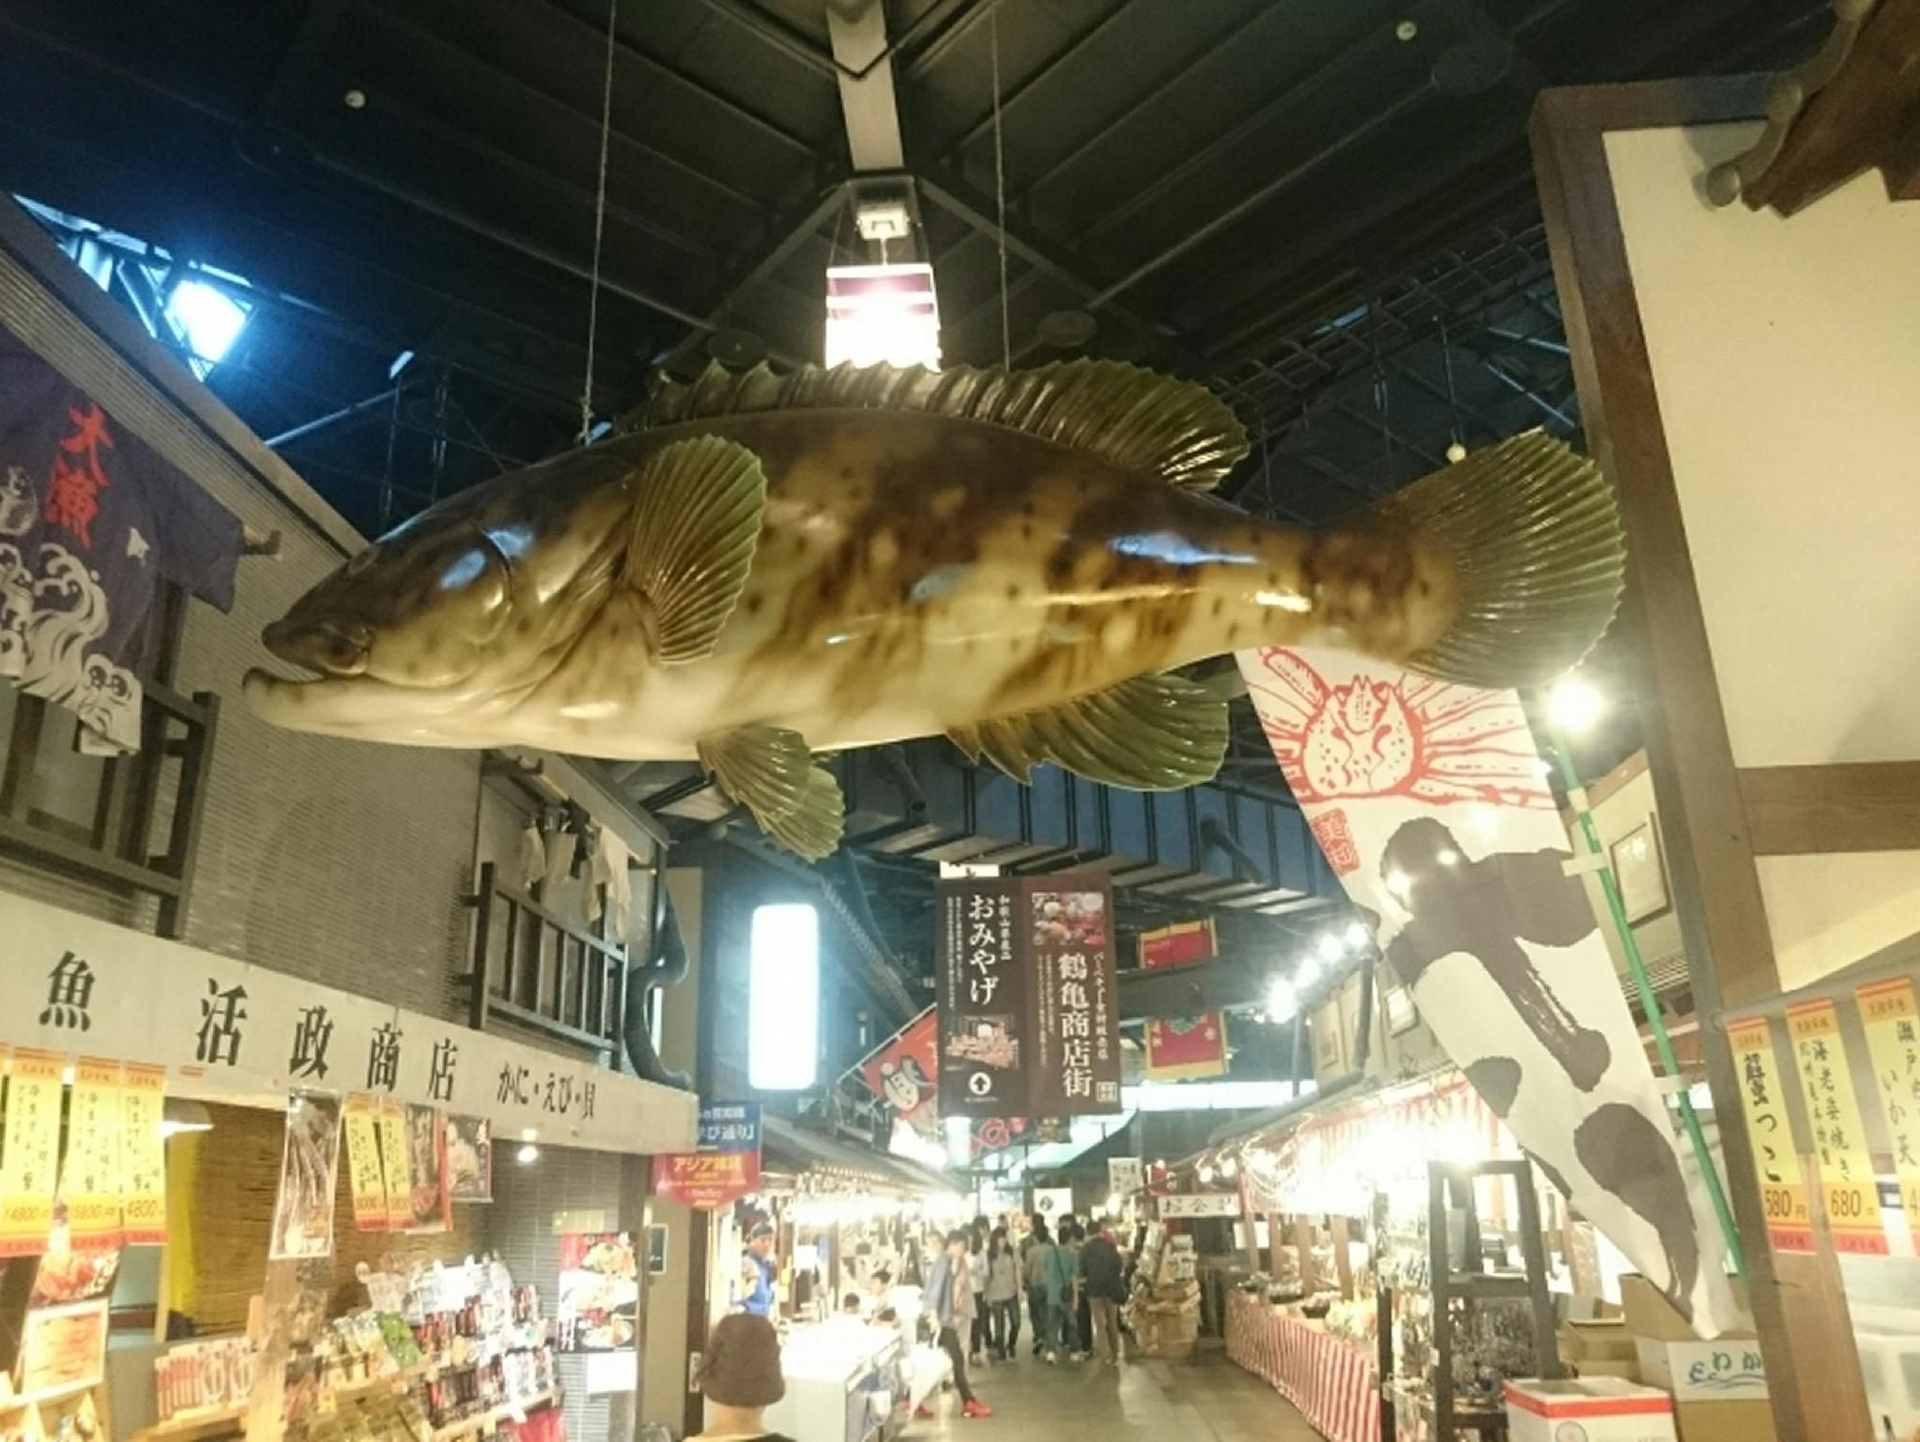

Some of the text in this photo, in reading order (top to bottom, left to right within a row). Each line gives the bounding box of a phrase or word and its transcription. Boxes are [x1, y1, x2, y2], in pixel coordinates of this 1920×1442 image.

[967, 894, 999, 1006] おみやげ
[1058, 952, 1093, 1098] 鶴亀商店街
